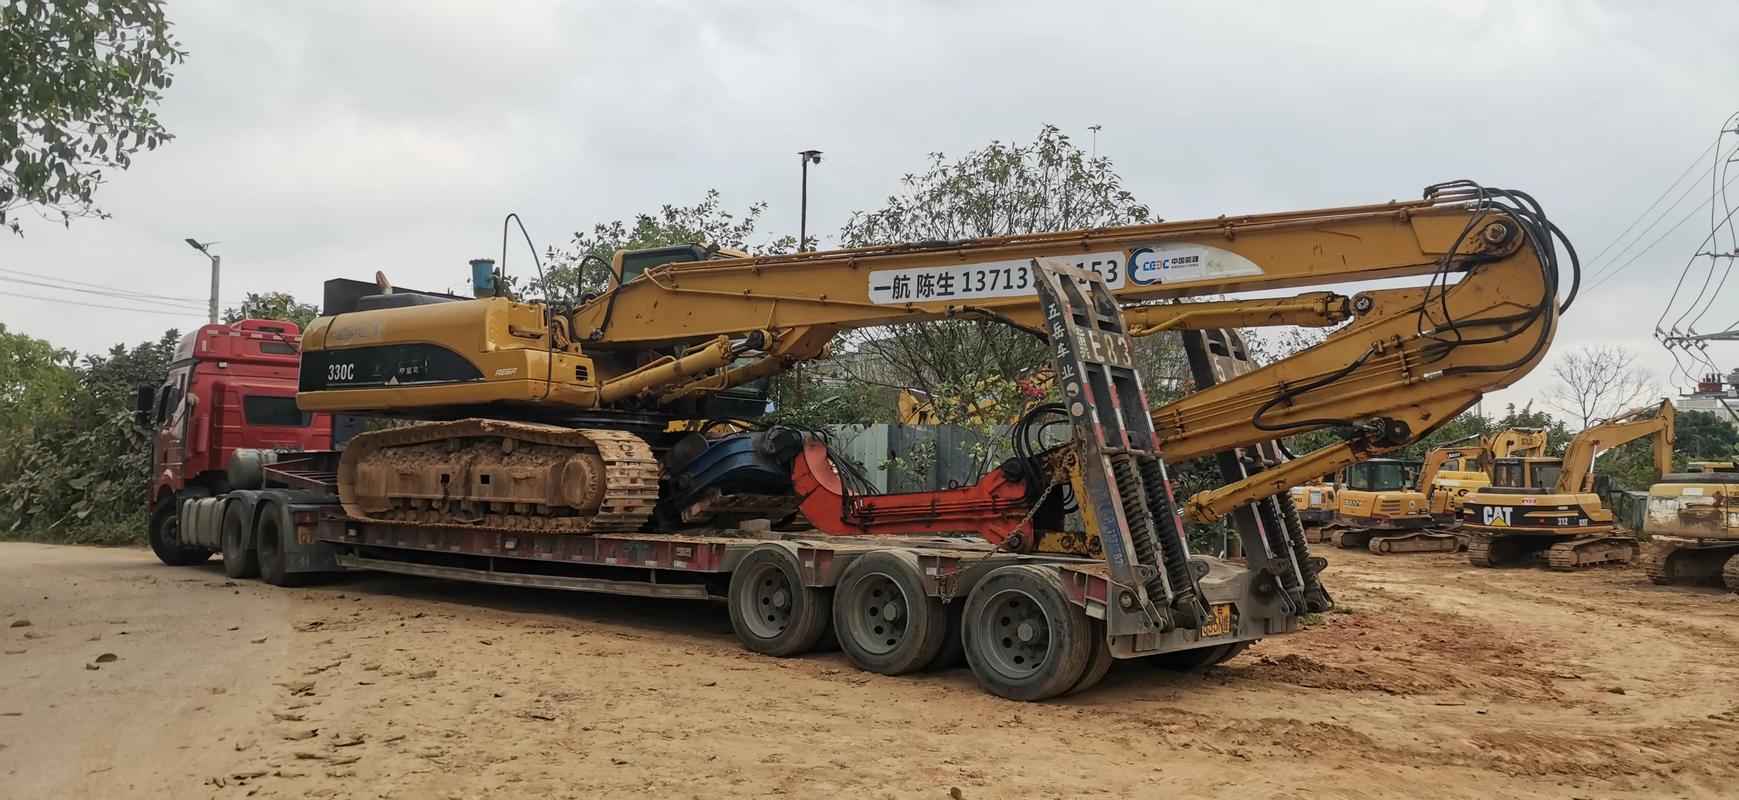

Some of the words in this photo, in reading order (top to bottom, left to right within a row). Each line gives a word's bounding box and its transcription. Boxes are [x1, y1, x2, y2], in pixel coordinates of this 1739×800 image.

[874, 274, 911, 299] 一航
[916, 271, 955, 298] 陈生
[1047, 303, 1075, 380] 五岳车业
[327, 363, 355, 381] 330C
[1483, 506, 1513, 527] CAT
[1557, 517, 1569, 526] 312
